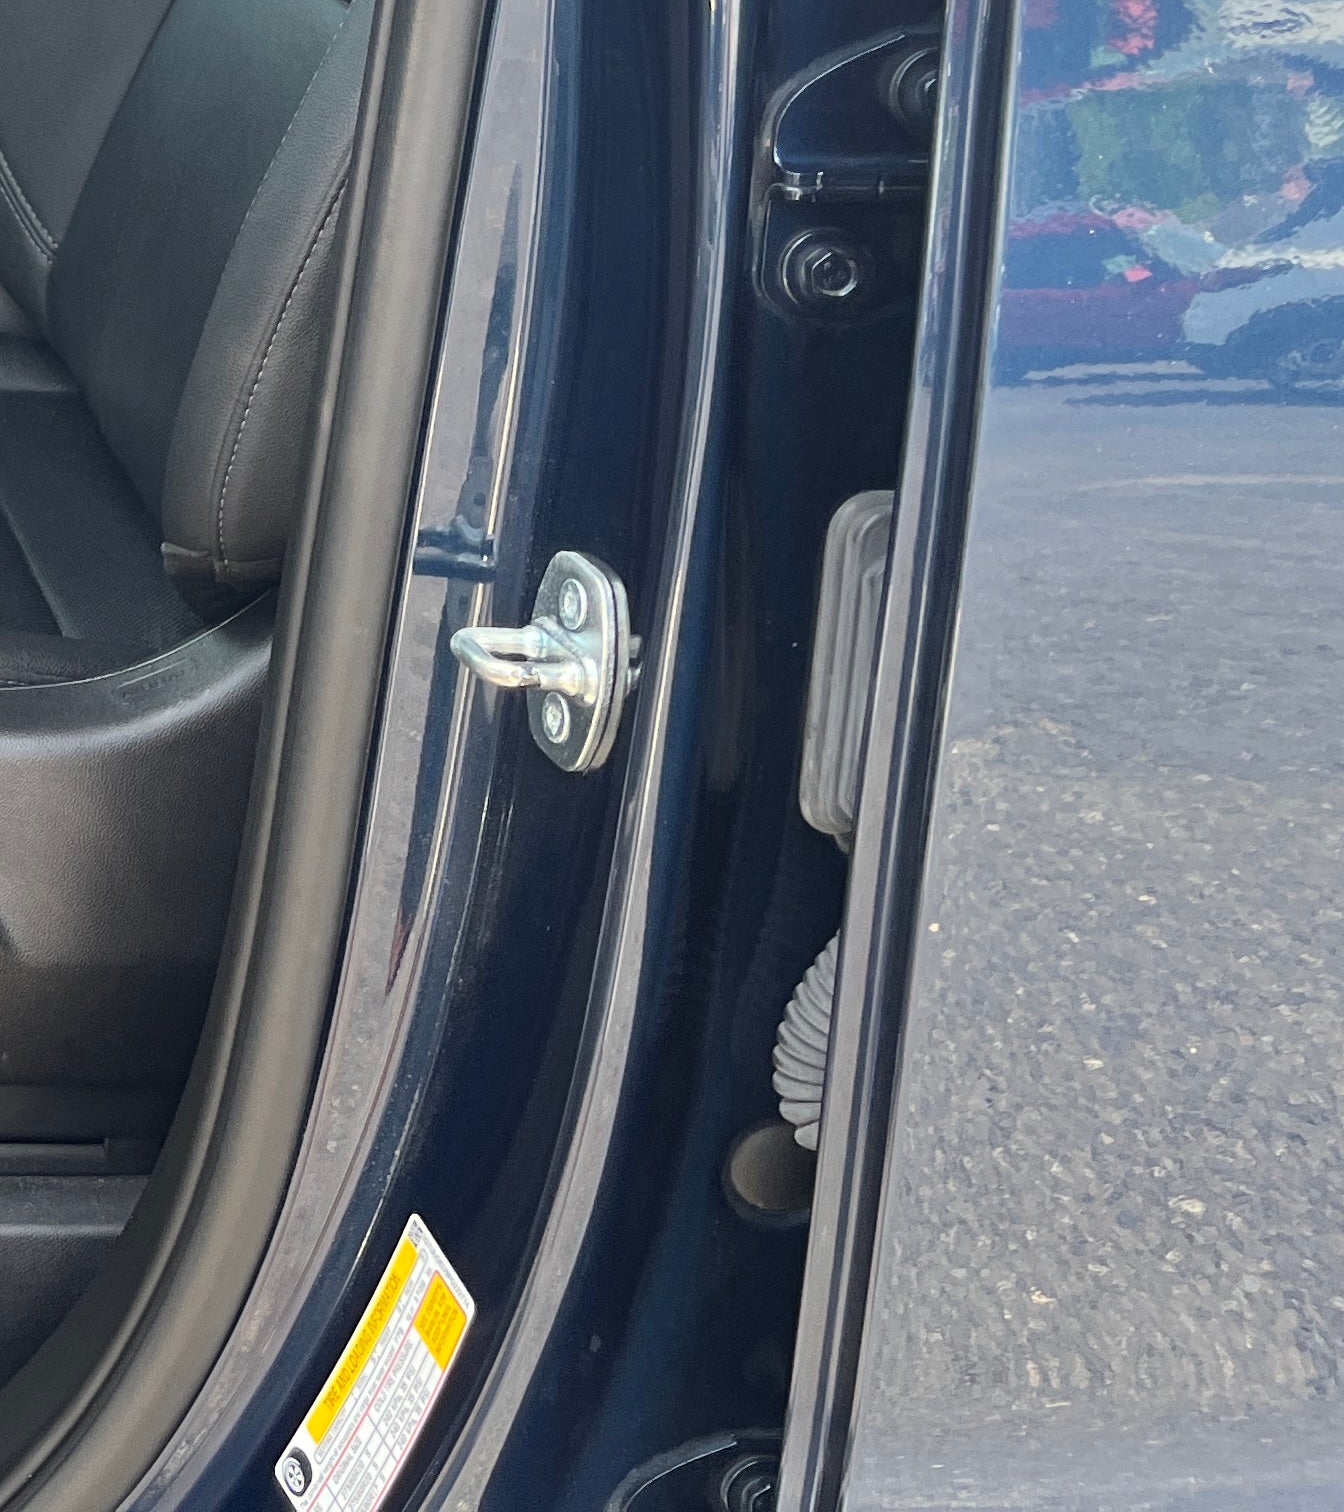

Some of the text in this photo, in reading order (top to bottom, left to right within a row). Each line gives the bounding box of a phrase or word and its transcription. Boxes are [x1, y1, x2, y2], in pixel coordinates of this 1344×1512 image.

[323, 1385, 338, 1409] TIRE
[336, 1367, 351, 1390] AND
[349, 1329, 372, 1374] LOADING
[367, 1273, 401, 1335] INFORMATION
